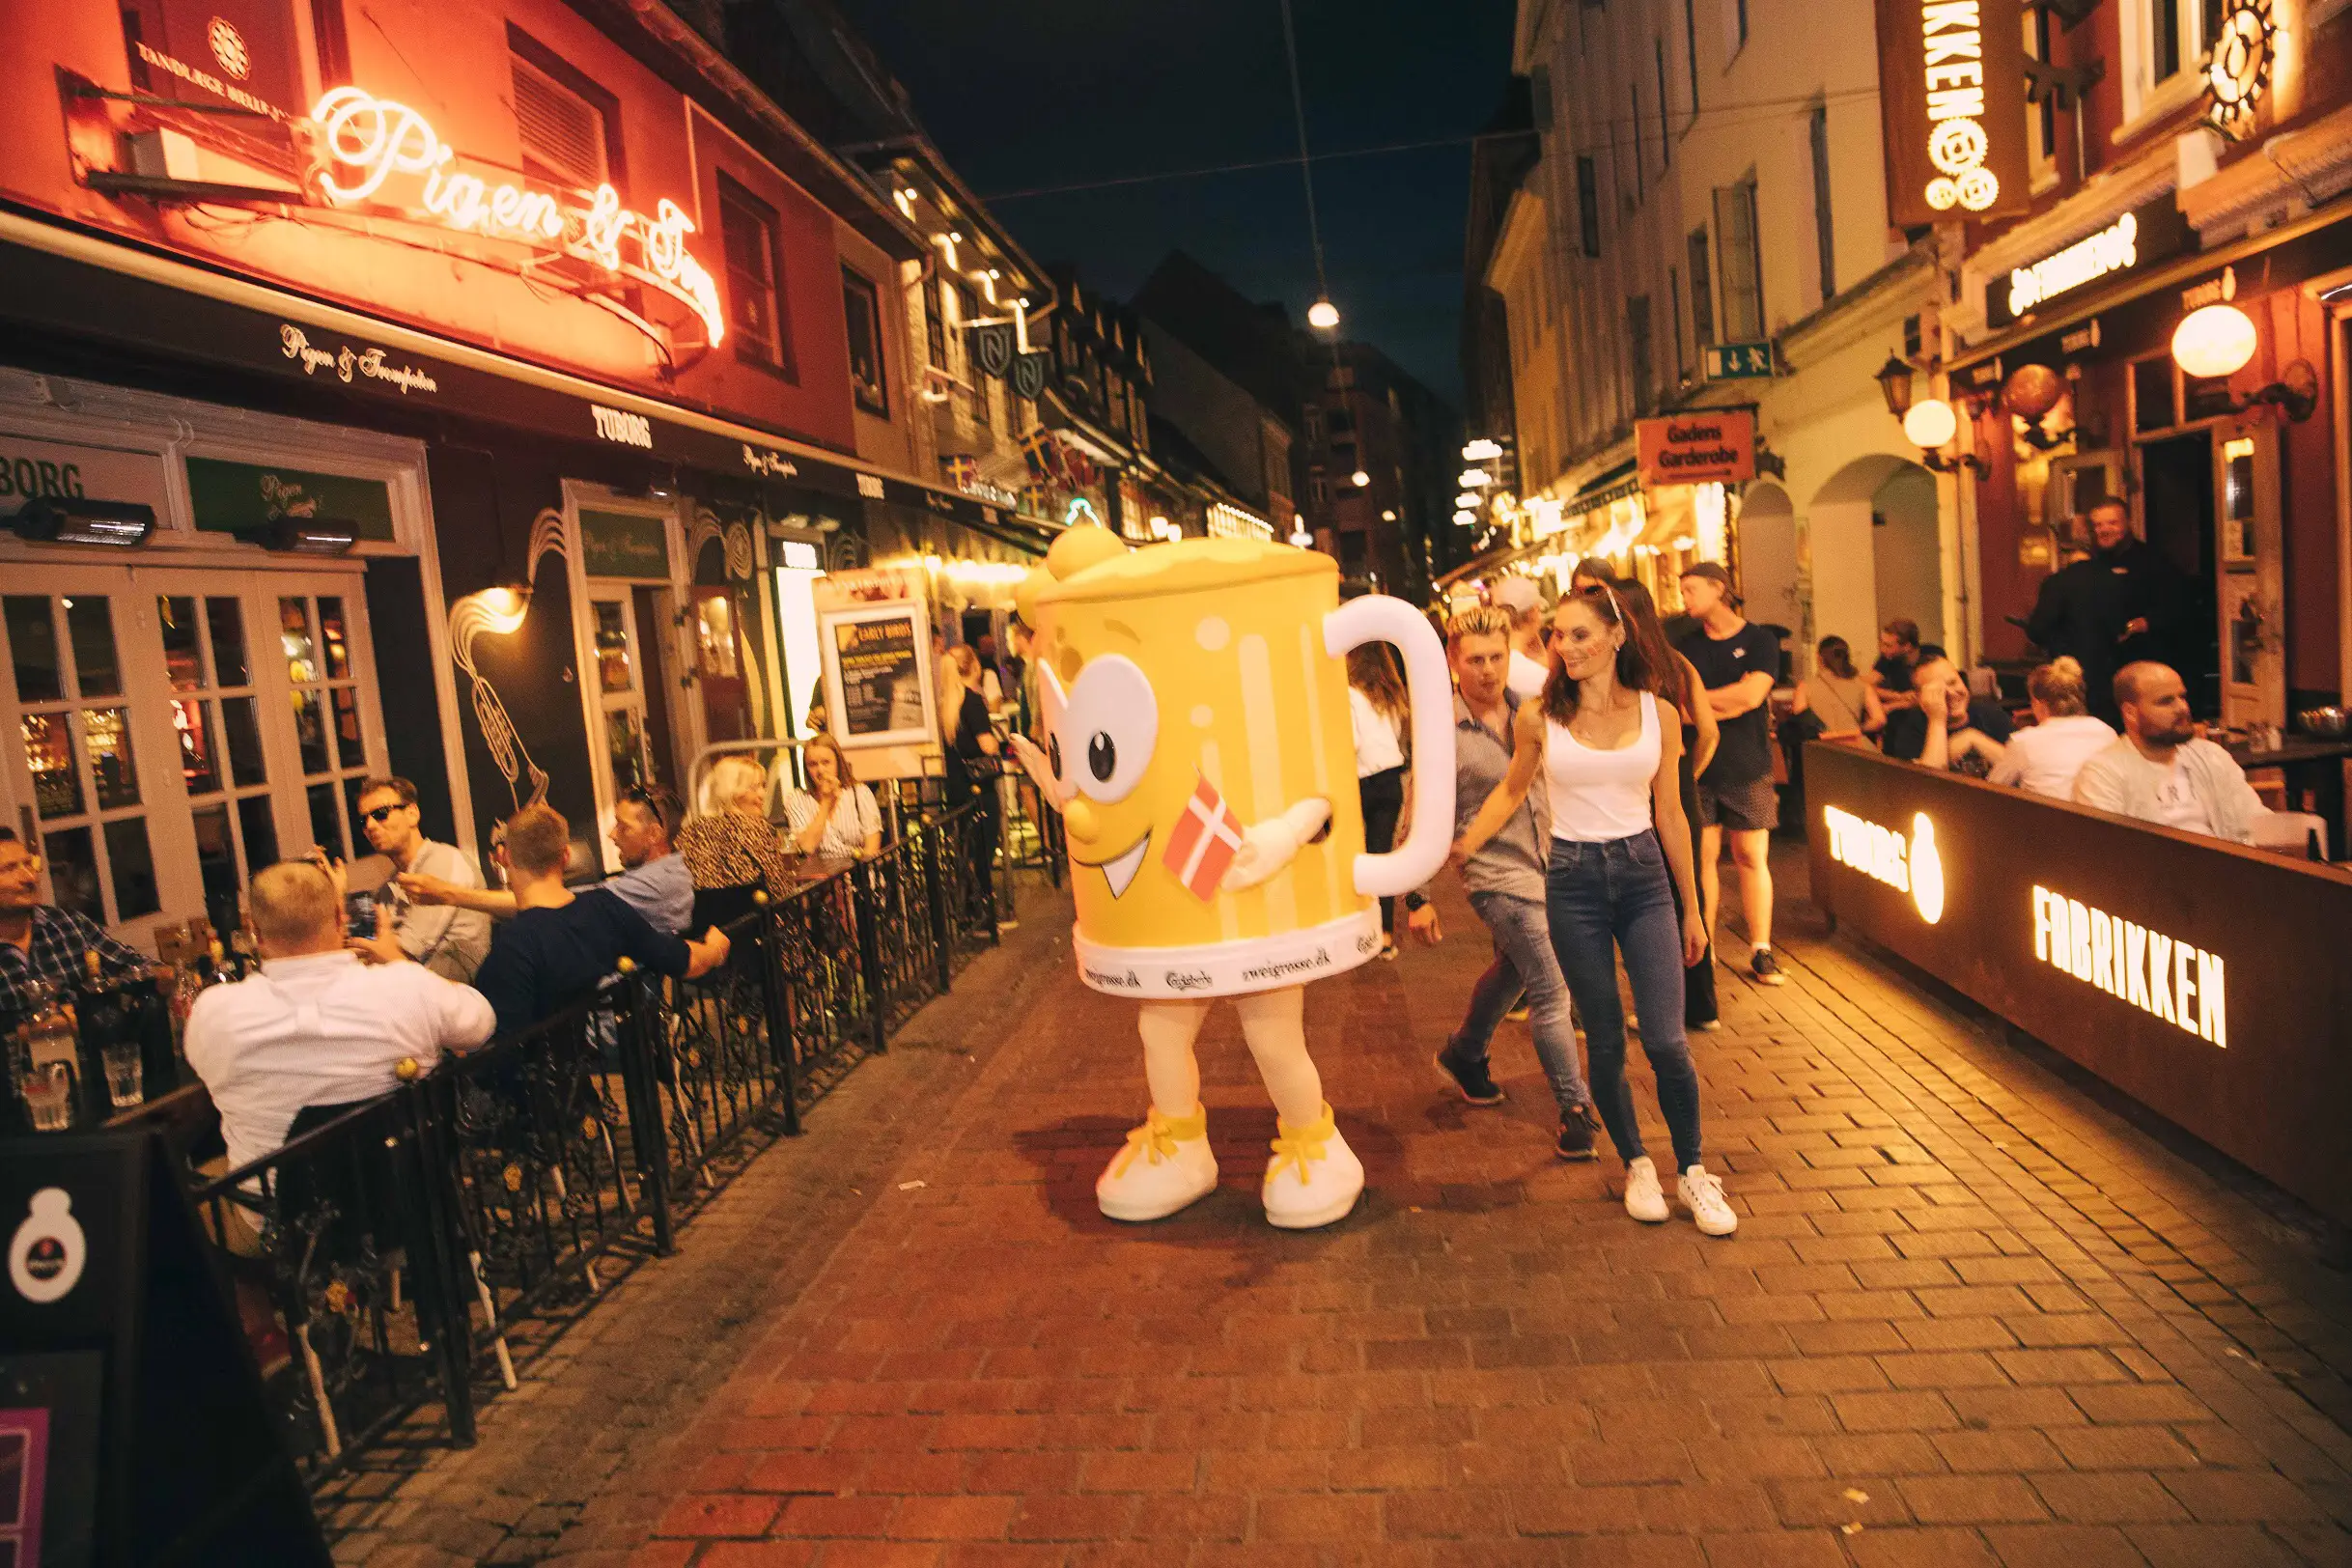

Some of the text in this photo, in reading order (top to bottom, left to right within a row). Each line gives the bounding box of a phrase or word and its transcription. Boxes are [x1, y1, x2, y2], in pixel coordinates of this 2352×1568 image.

[1922, 0, 1985, 121] KKEN
[591, 404, 653, 449] TUBORG
[1667, 423, 1722, 444] Gadens
[1659, 445, 1739, 467] Garderobe
[2033, 884, 2227, 1049] FABRIKKEN
